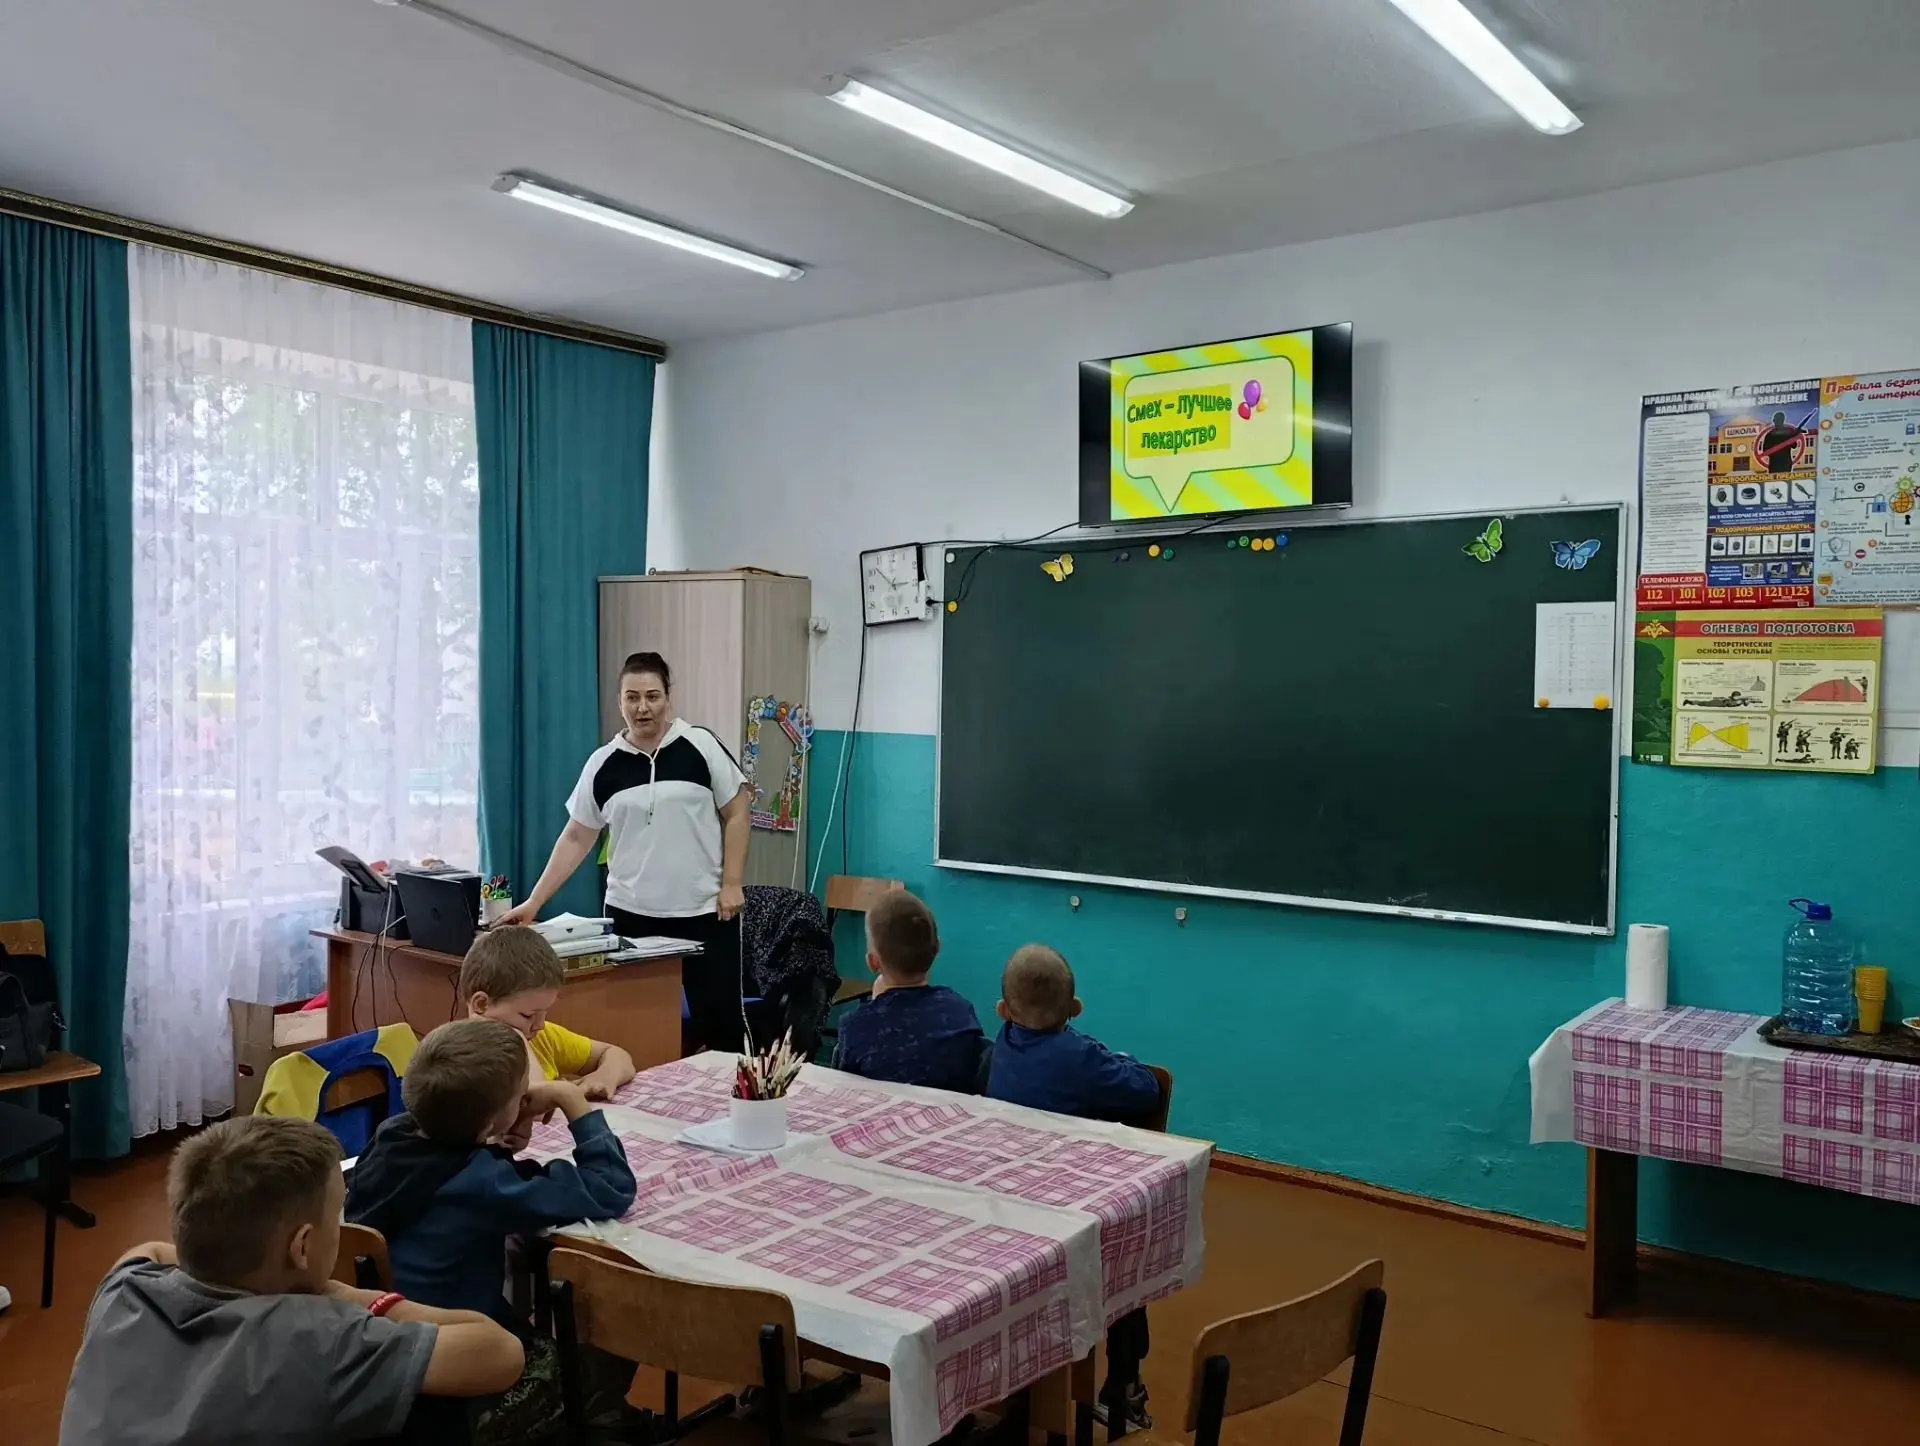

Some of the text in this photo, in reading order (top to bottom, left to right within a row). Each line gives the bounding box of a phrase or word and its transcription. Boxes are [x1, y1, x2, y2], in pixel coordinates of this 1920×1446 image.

[1825, 380, 1882, 394] Правила
[1127, 399, 1163, 423] Смех
[1726, 427, 1757, 436] ШКОЛА
[1140, 424, 1217, 455] лекарство
[1641, 576, 1679, 584] ТЕЛЕФОНЫ
[1646, 586, 1810, 600] 112 101 102 103 121 123
[1700, 623, 1855, 634] ОГНЕВАЯ ПОДГОТОВКА
